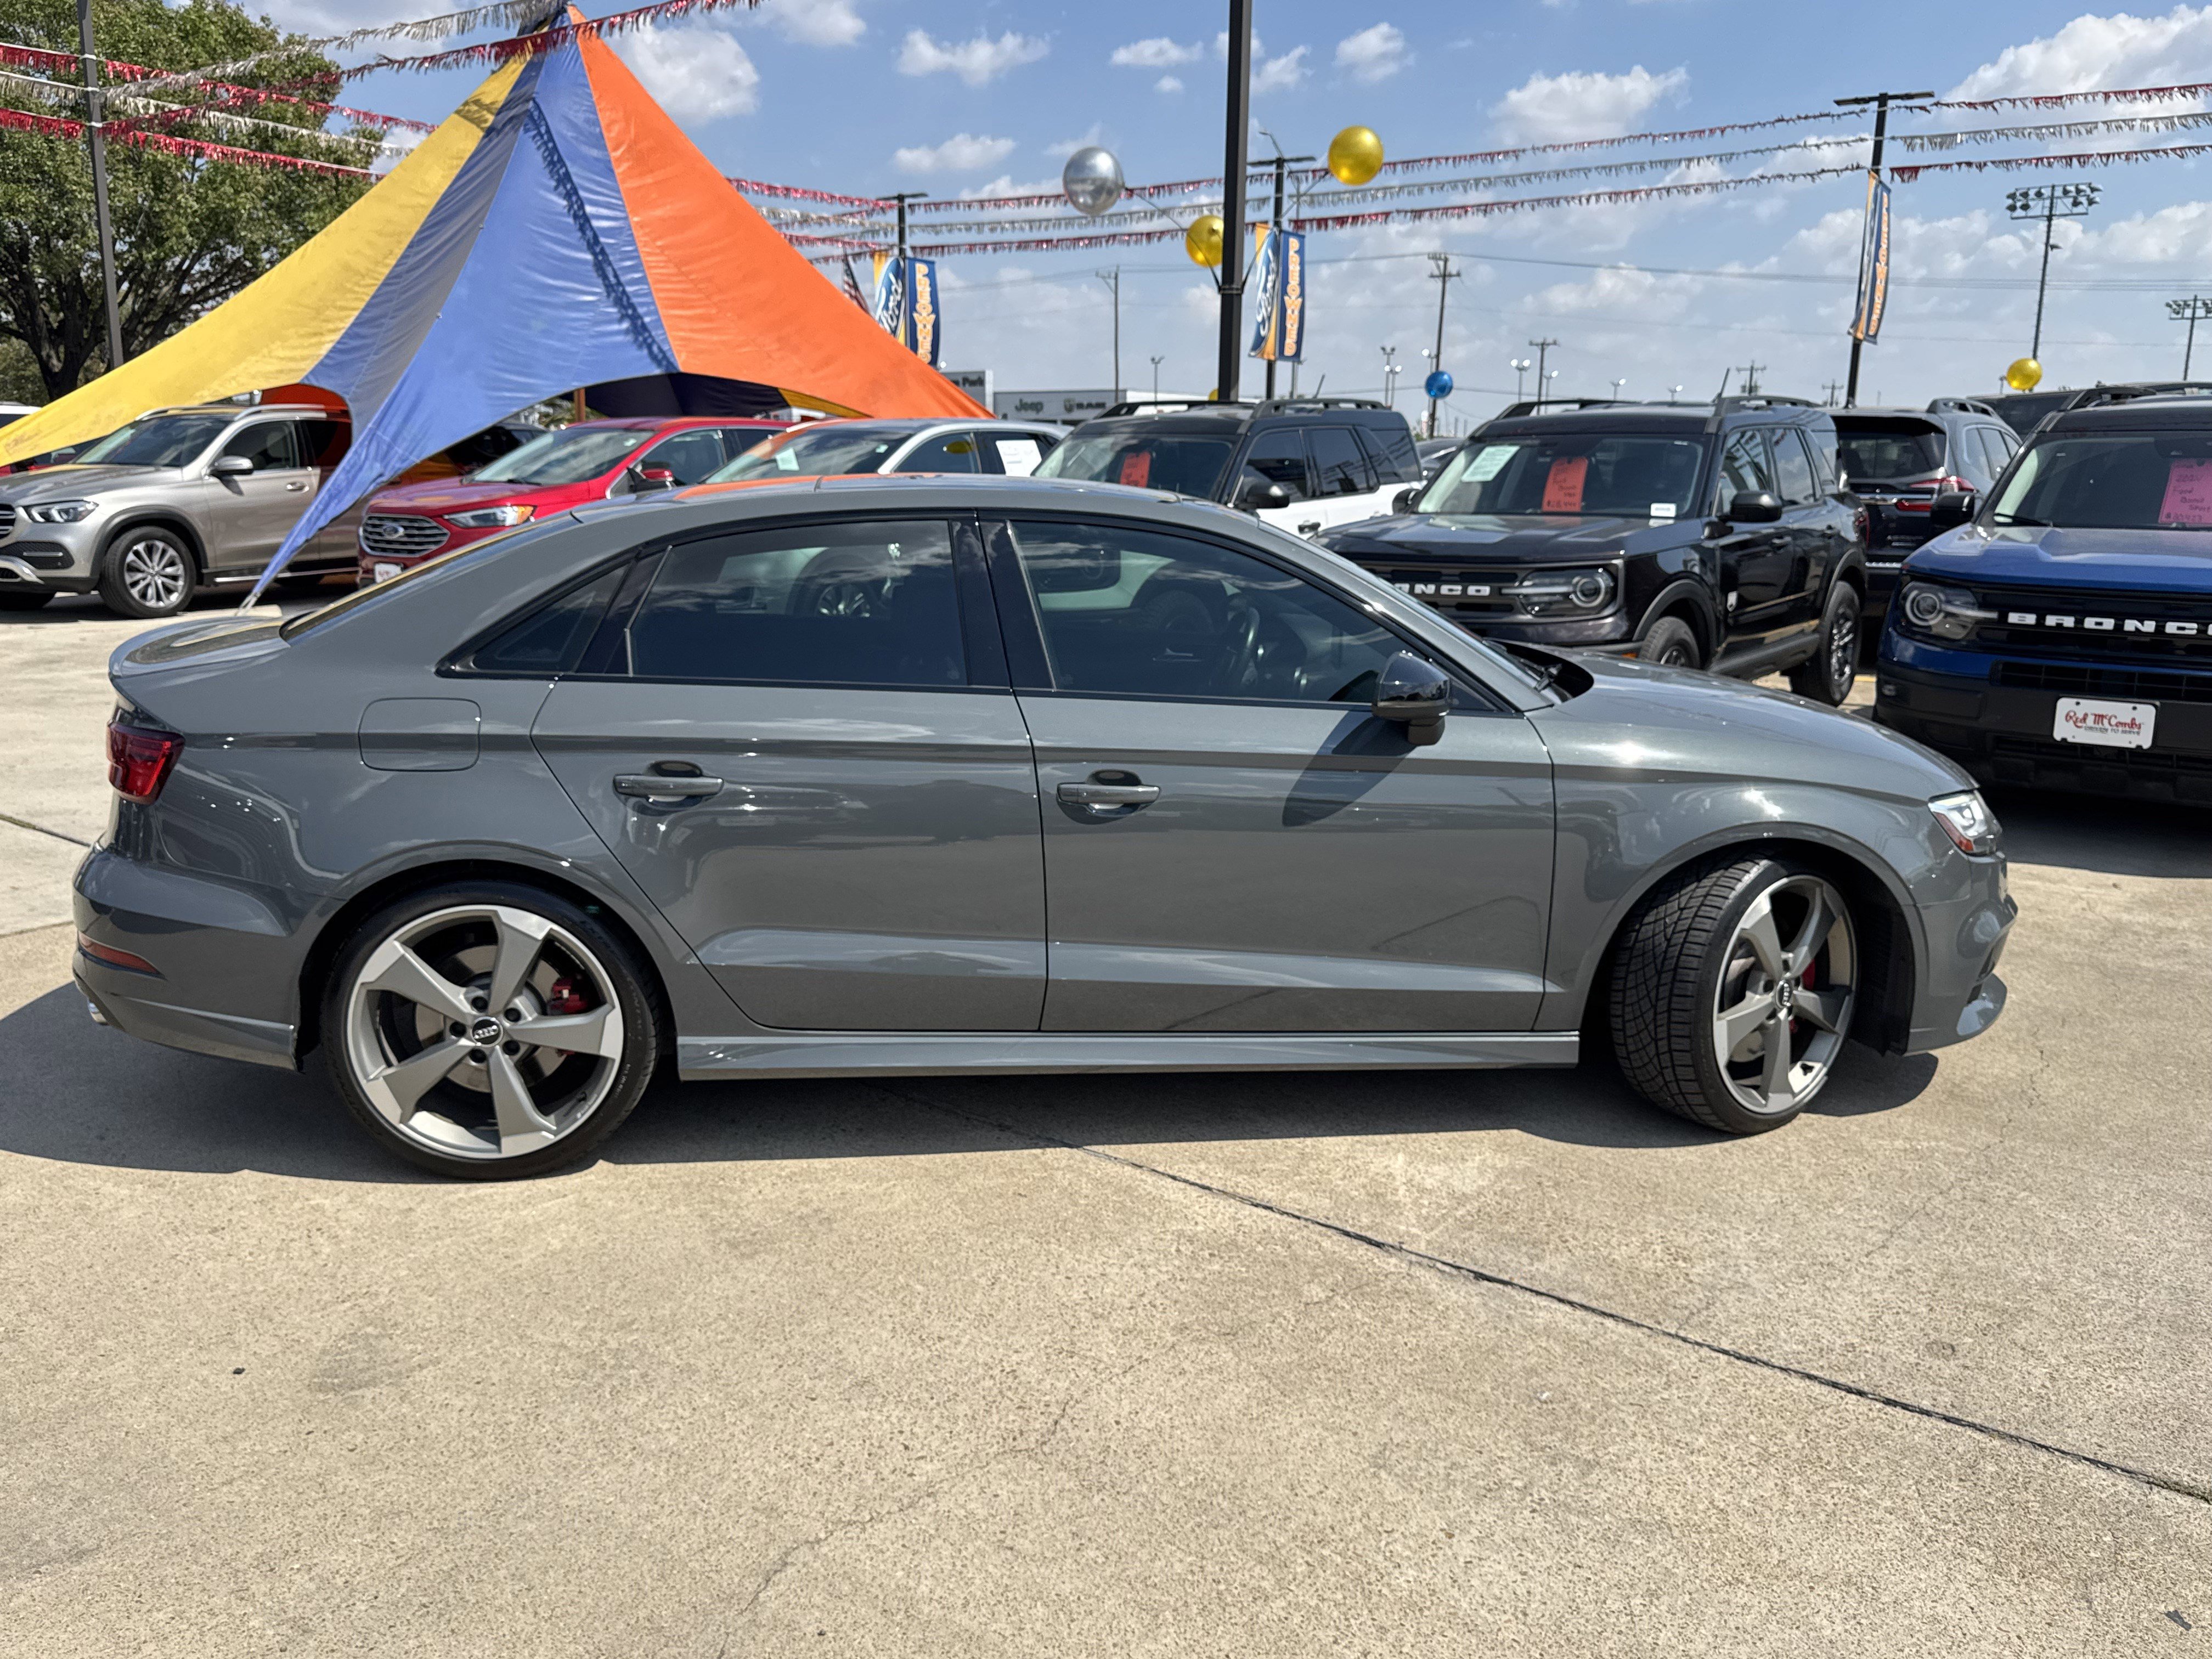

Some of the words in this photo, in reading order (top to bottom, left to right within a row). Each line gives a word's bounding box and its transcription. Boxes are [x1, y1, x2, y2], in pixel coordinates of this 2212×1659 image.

[1284, 238, 1303, 357] PREOWNED
[2008, 612, 2212, 635] BRONC
[2064, 709, 2089, 729] Red
